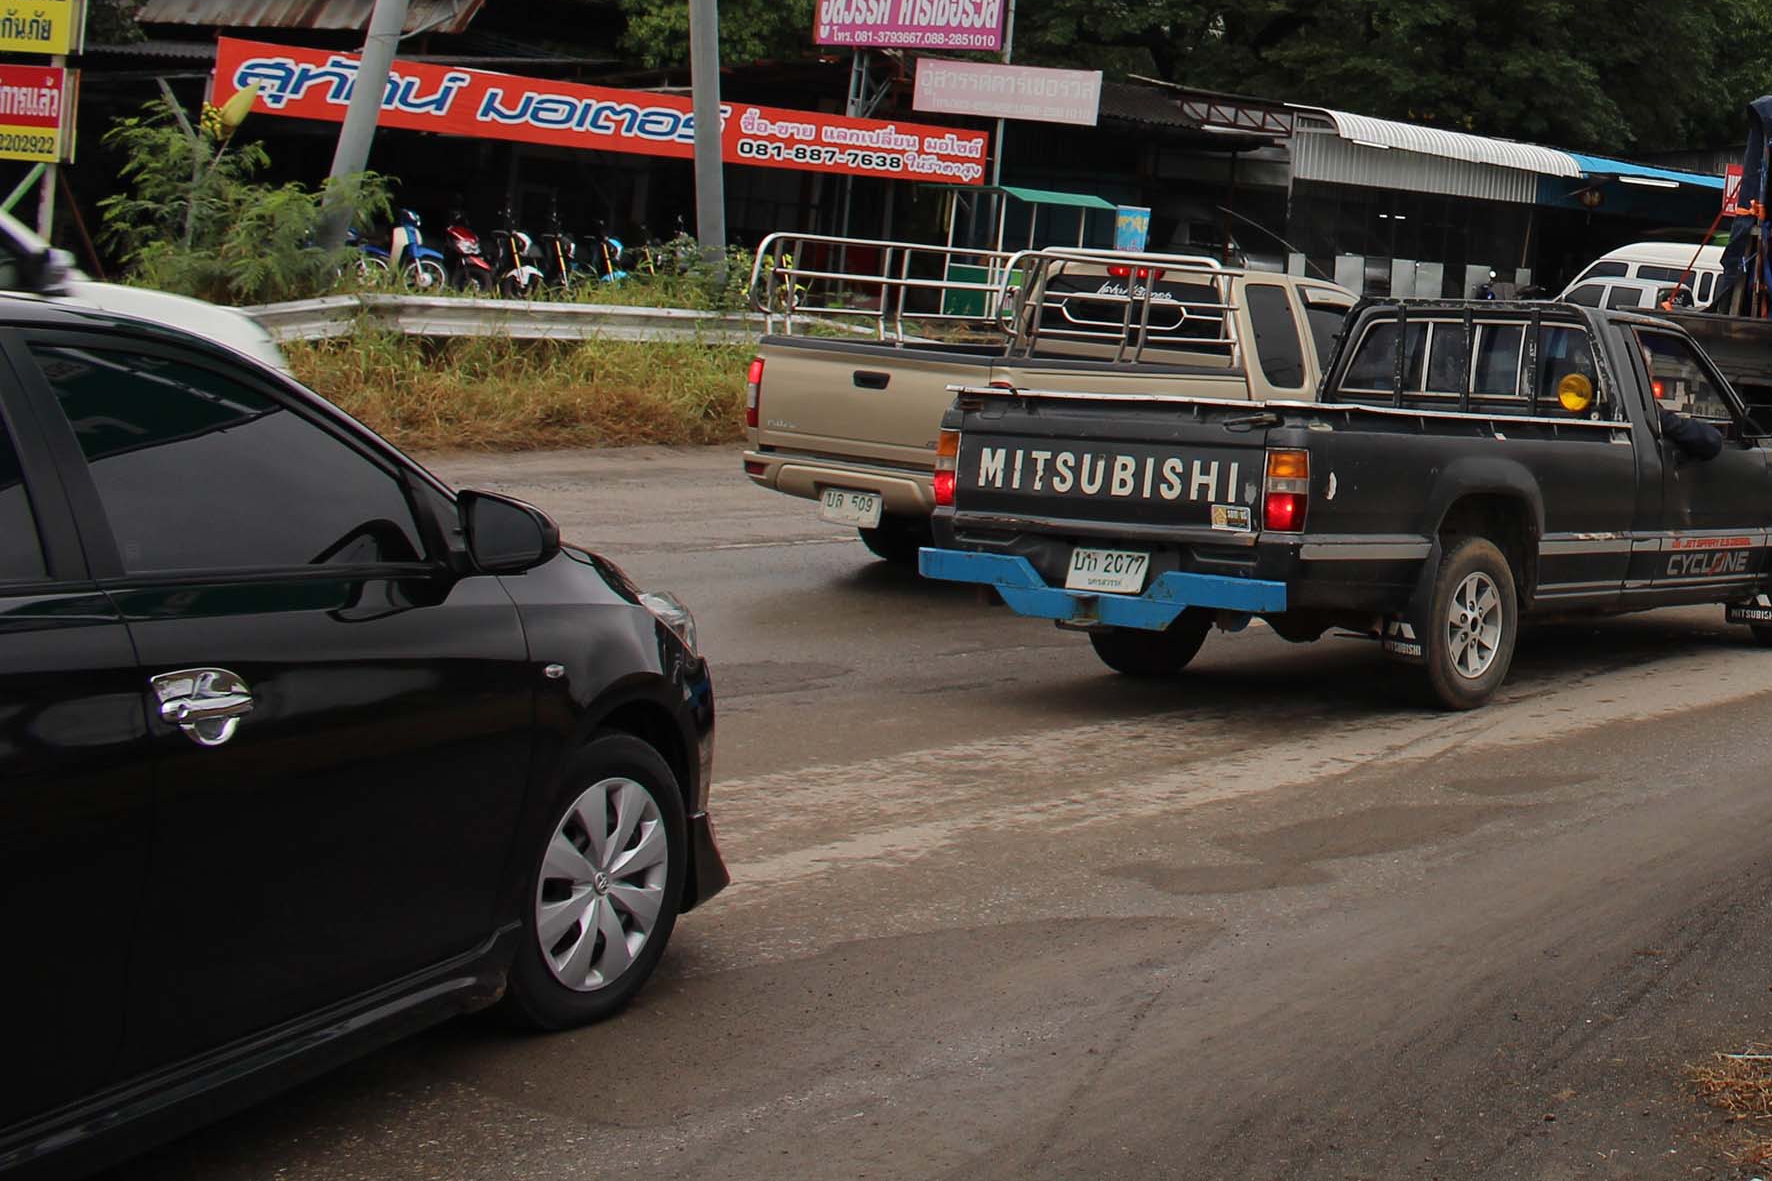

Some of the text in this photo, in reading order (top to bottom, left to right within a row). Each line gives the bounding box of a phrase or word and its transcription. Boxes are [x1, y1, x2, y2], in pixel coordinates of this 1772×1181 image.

[0, 76, 60, 117] การแล้ว
[738, 139, 903, 170] 081-887-7638
[978, 447, 1239, 503] MITSUBISHI
[1104, 553, 1145, 574] 2077
[1667, 551, 1750, 575] CYCLONE
